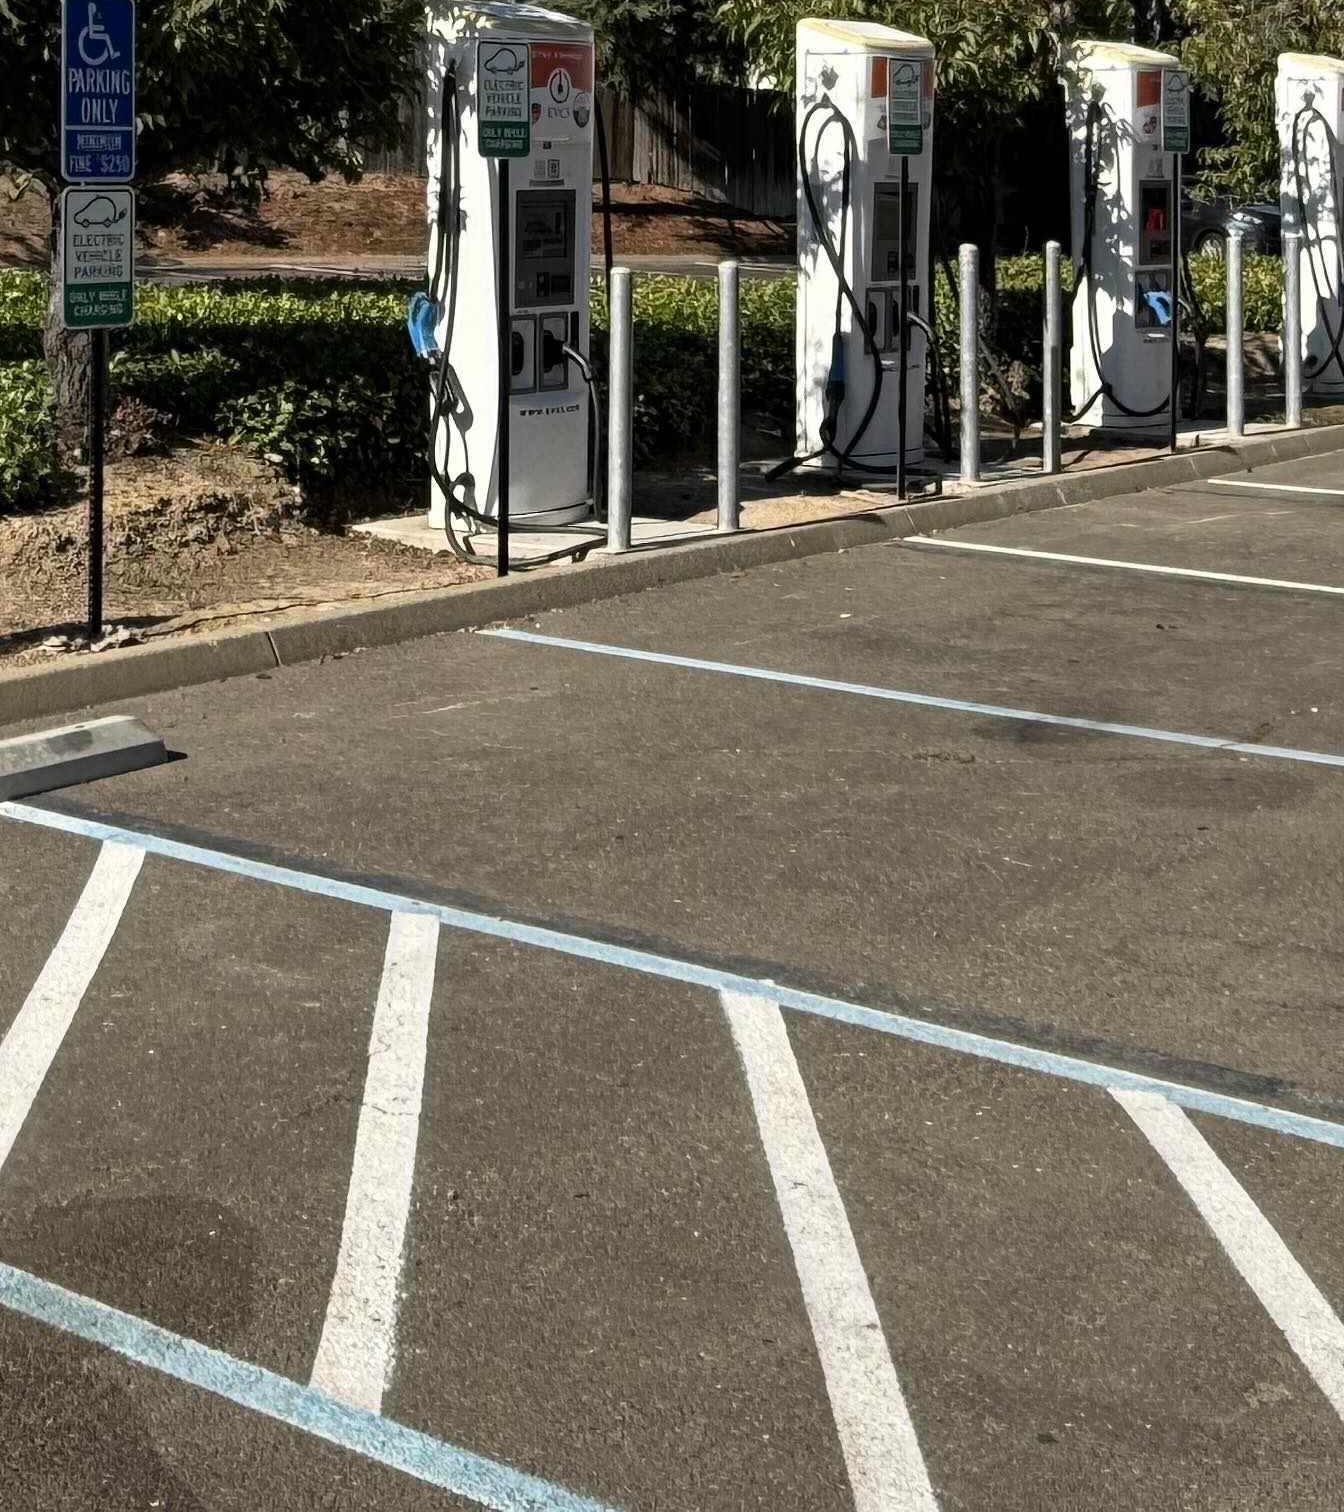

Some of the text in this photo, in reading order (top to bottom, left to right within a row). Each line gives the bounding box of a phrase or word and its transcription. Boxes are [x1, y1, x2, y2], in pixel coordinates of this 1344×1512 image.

[68, 67, 131, 95] PARKING
[81, 96, 119, 124] ONLY
[69, 154, 93, 173] FINE
[72, 233, 125, 248] ELECTRIC
[75, 249, 123, 263] VECLE
[73, 265, 124, 280] PARKING
